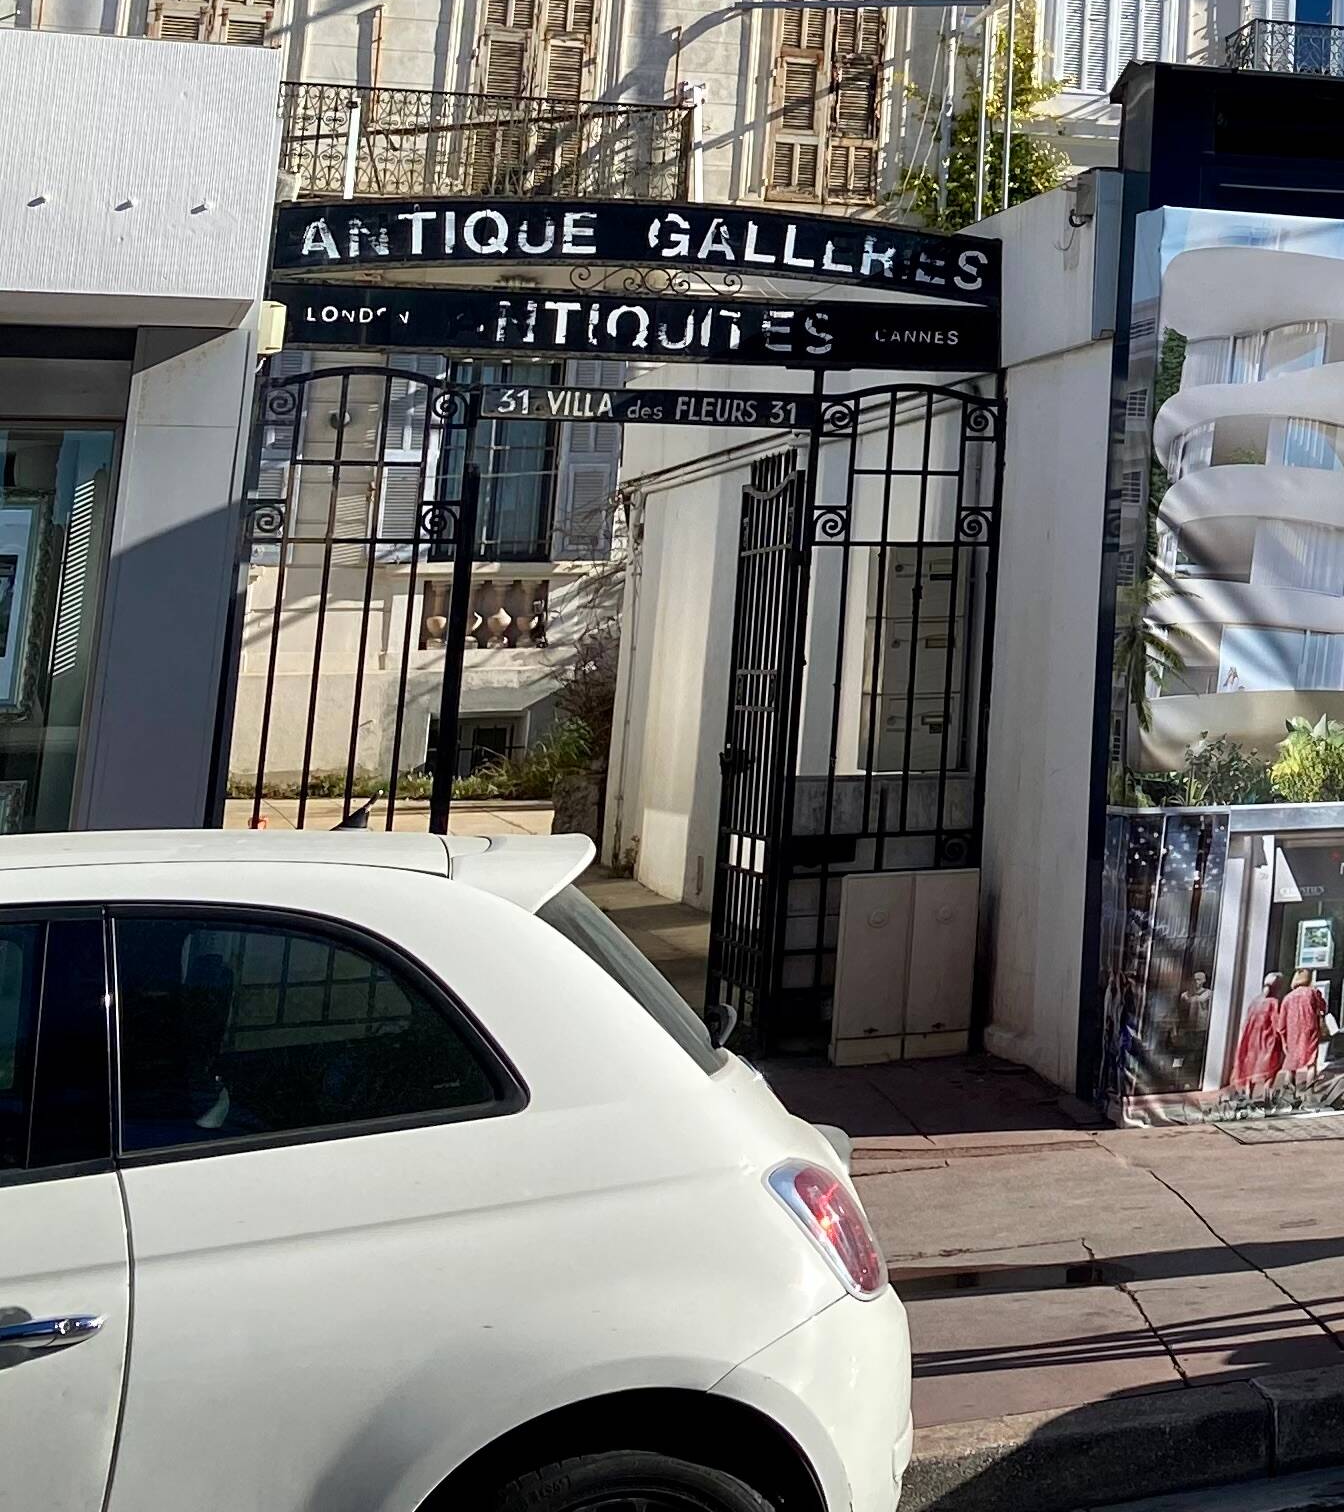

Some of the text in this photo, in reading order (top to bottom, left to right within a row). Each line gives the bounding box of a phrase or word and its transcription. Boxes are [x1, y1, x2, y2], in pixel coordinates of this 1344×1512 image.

[302, 209, 597, 259] ANTIQUE
[497, 389, 797, 425] 31 VILLA des FLEURS 31
